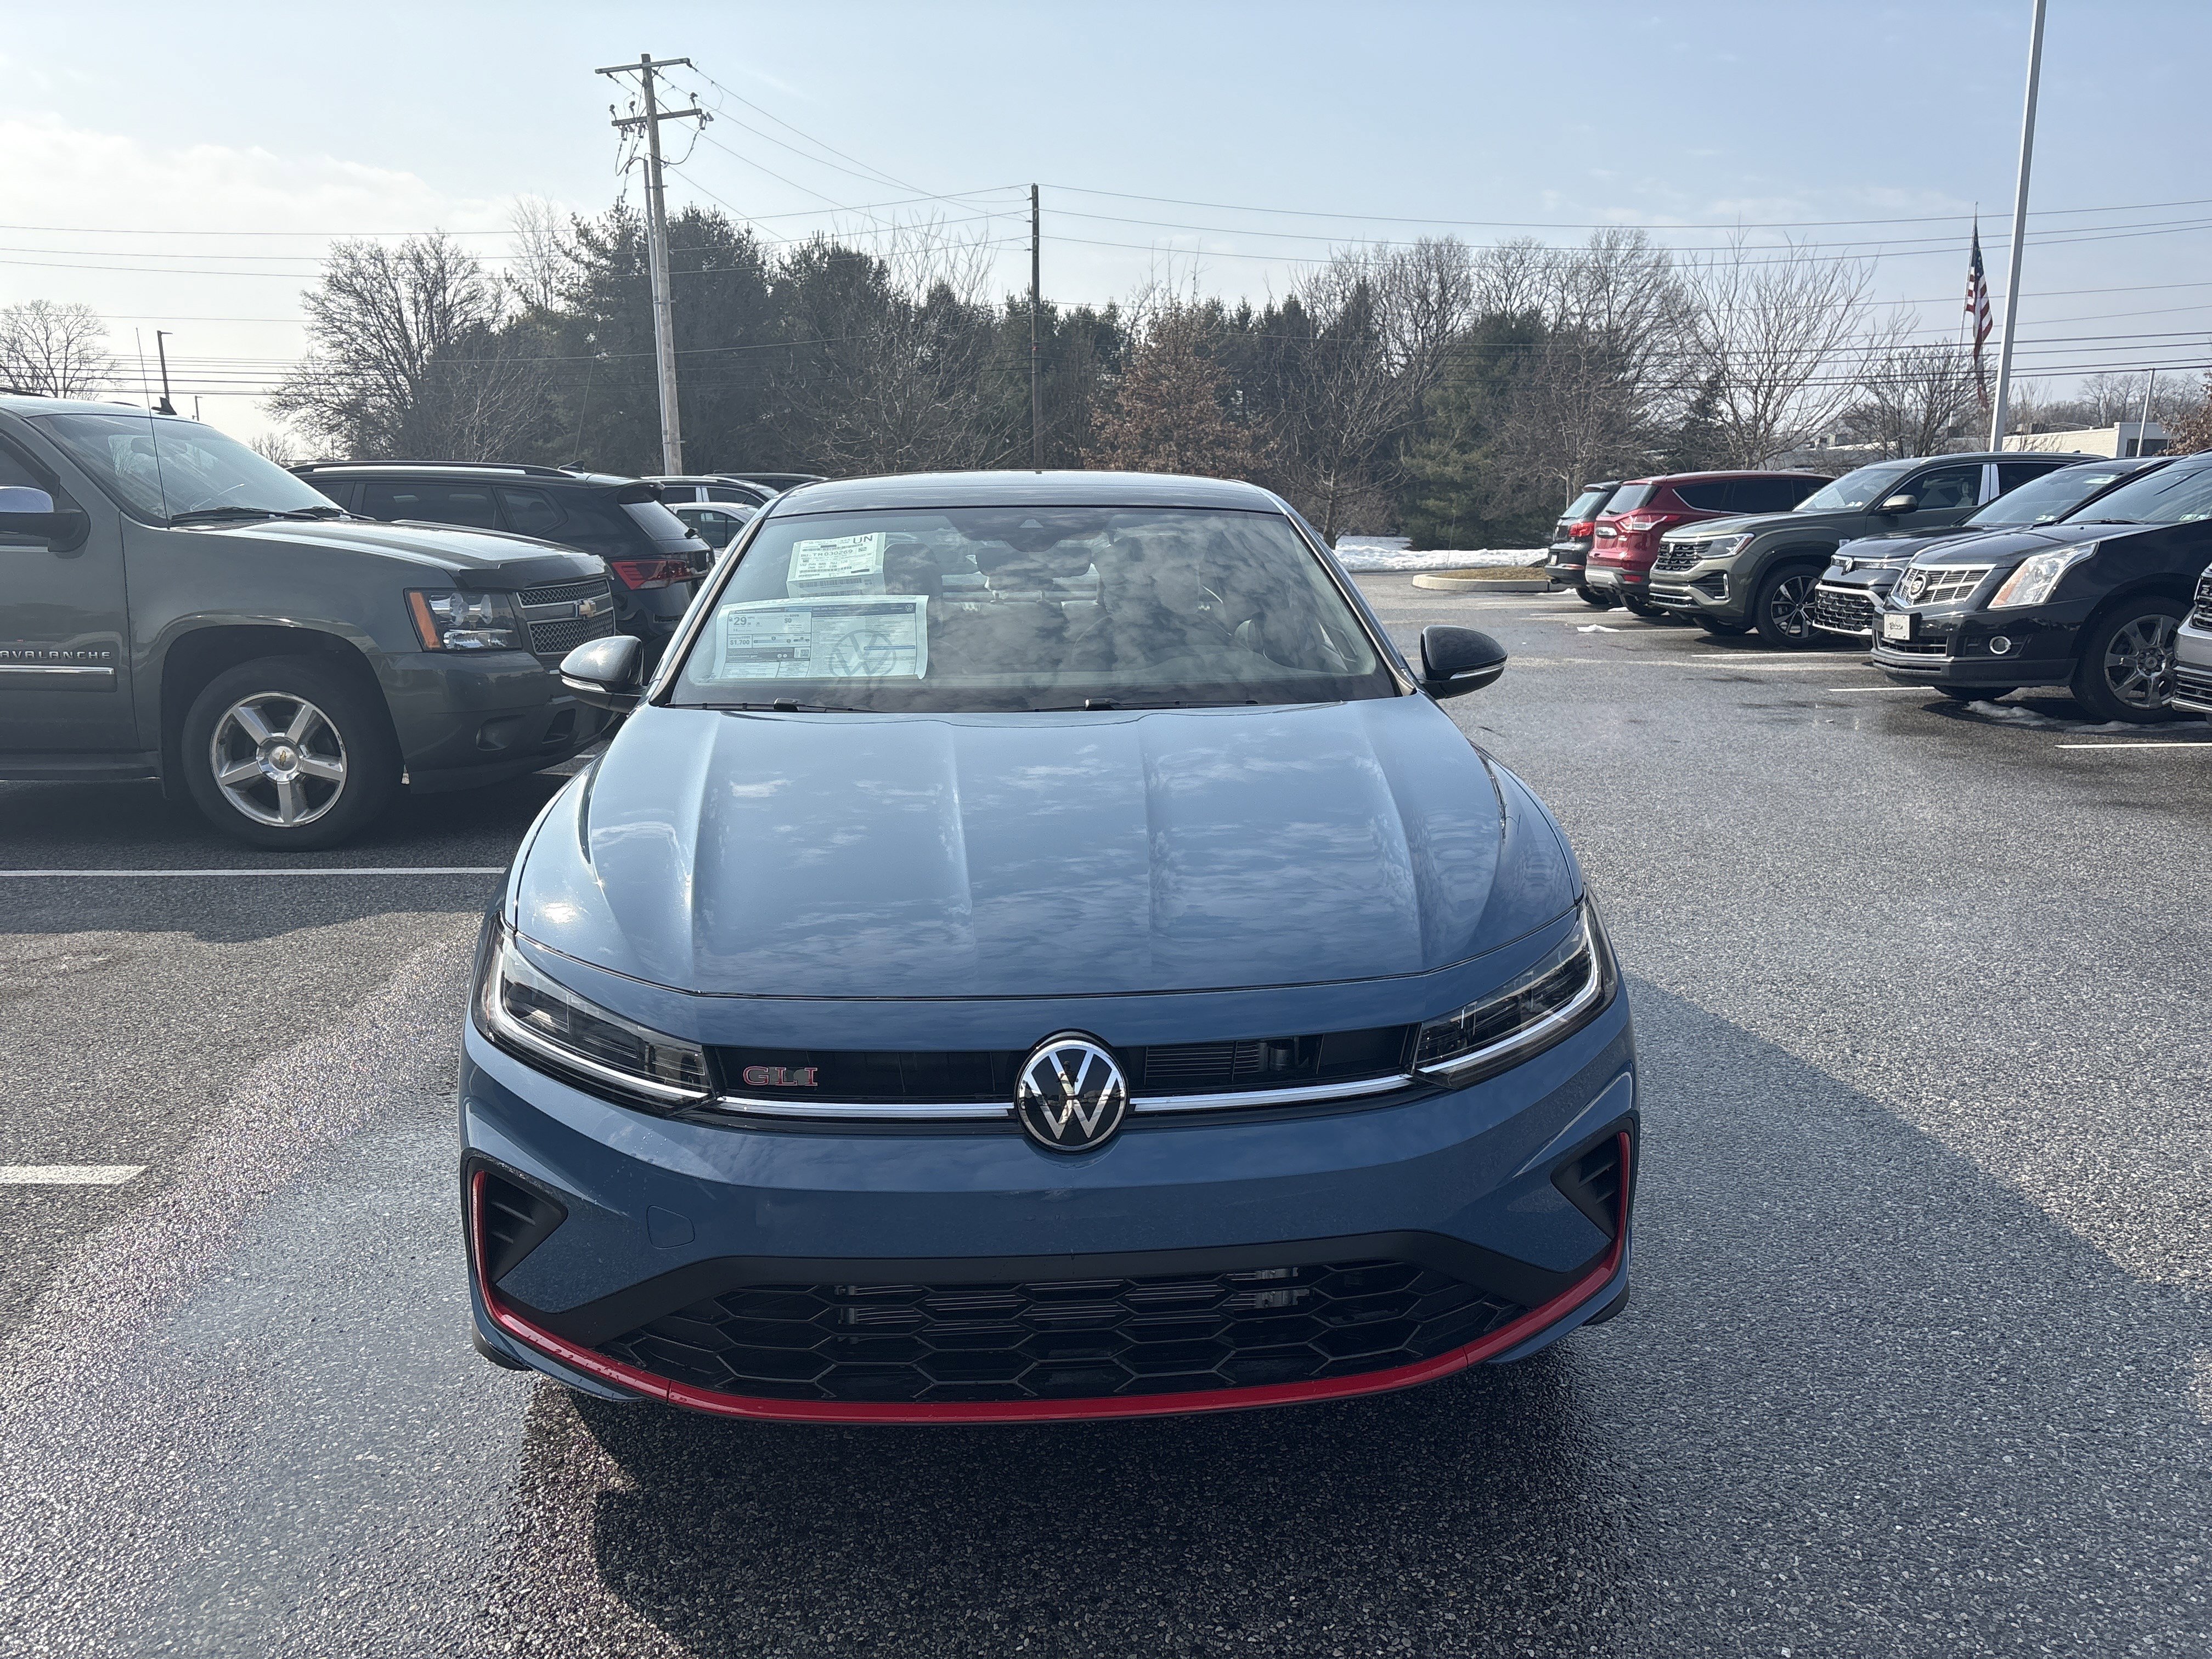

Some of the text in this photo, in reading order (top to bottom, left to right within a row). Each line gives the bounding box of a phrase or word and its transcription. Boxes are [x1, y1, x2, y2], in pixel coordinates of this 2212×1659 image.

[853, 535, 873, 544] UN
[733, 617, 747, 626] 29
[0, 650, 111, 659] AVALANCHE
[743, 1066, 818, 1086] GLI
